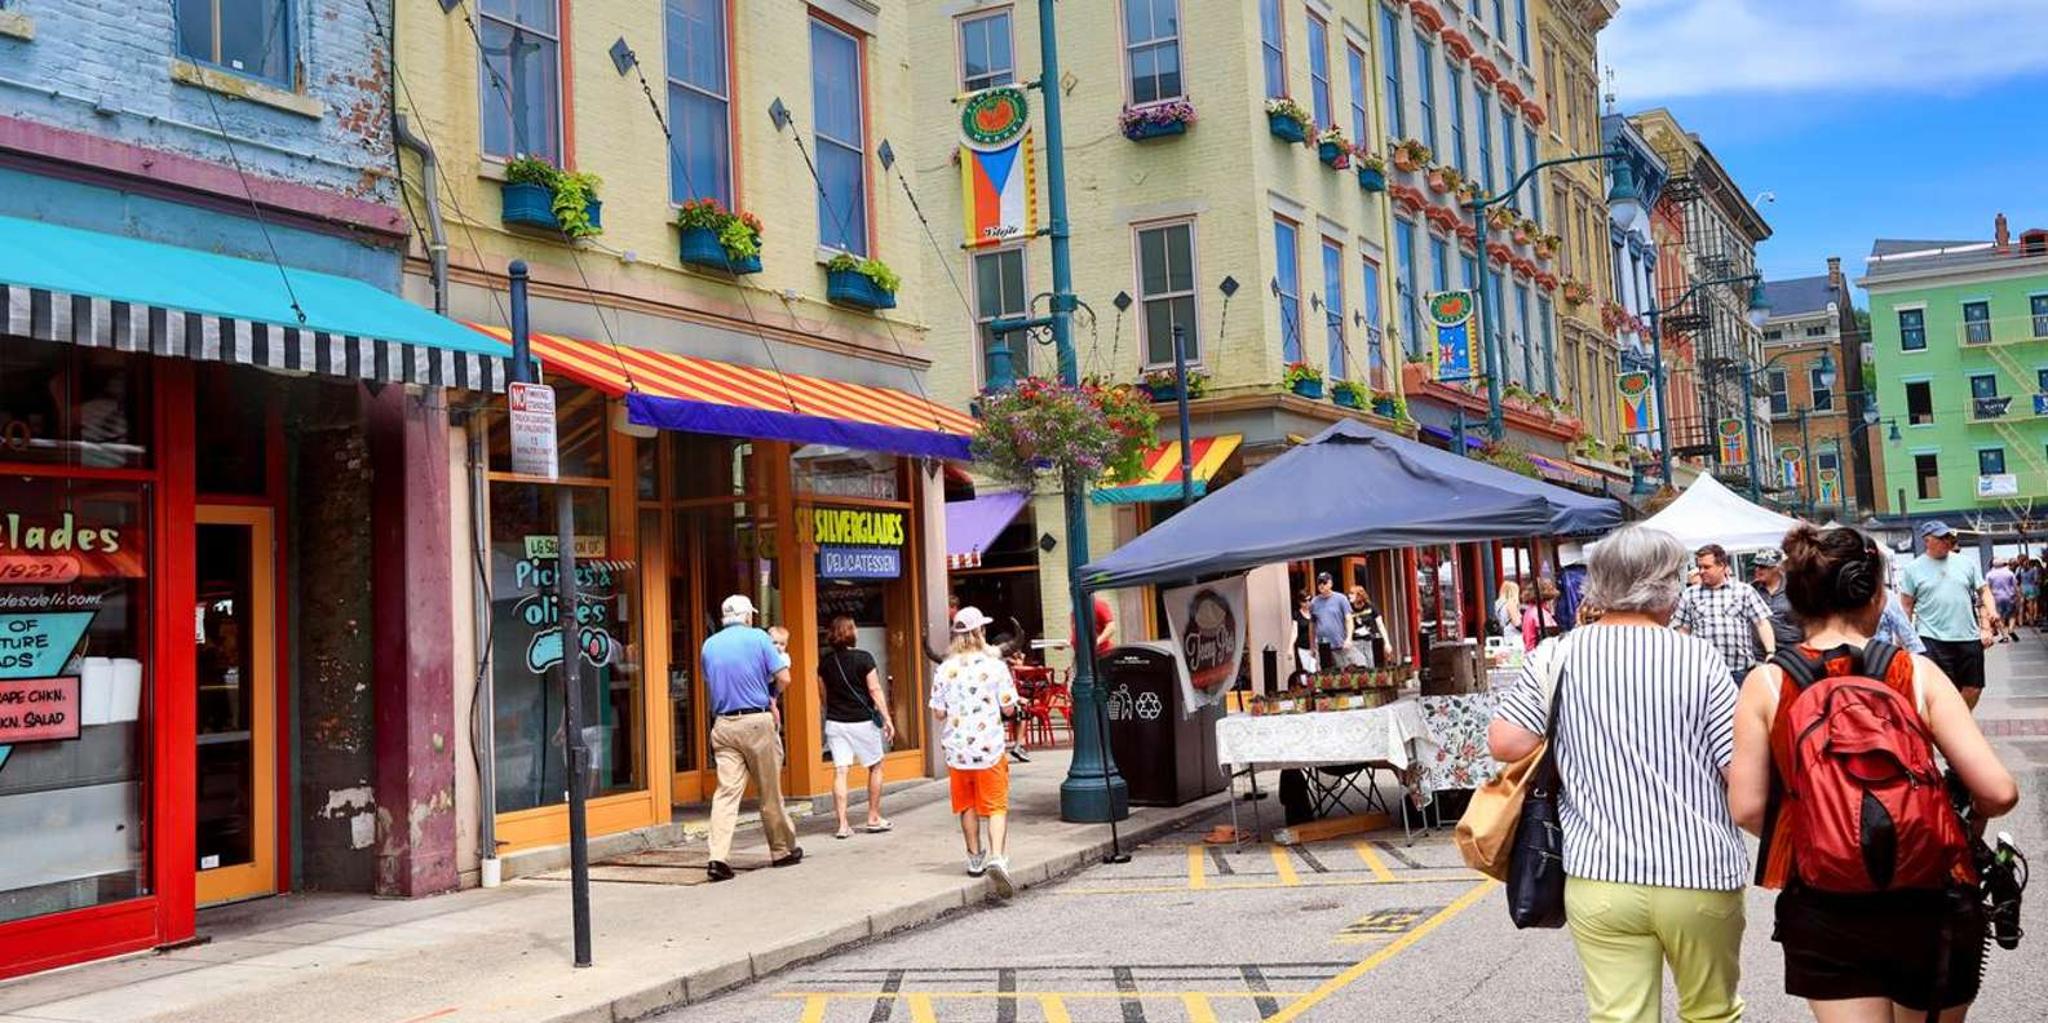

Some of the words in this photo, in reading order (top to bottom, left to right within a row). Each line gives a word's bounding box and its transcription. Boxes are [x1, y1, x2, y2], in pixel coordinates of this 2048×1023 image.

[512, 386, 526, 411] NO
[0, 512, 120, 554] lades
[515, 558, 594, 590] Pices
[826, 551, 896, 574] DELICATESSEN
[524, 596, 607, 625] olies
[8, 619, 39, 633] OF
[24, 711, 65, 728] SALAD
